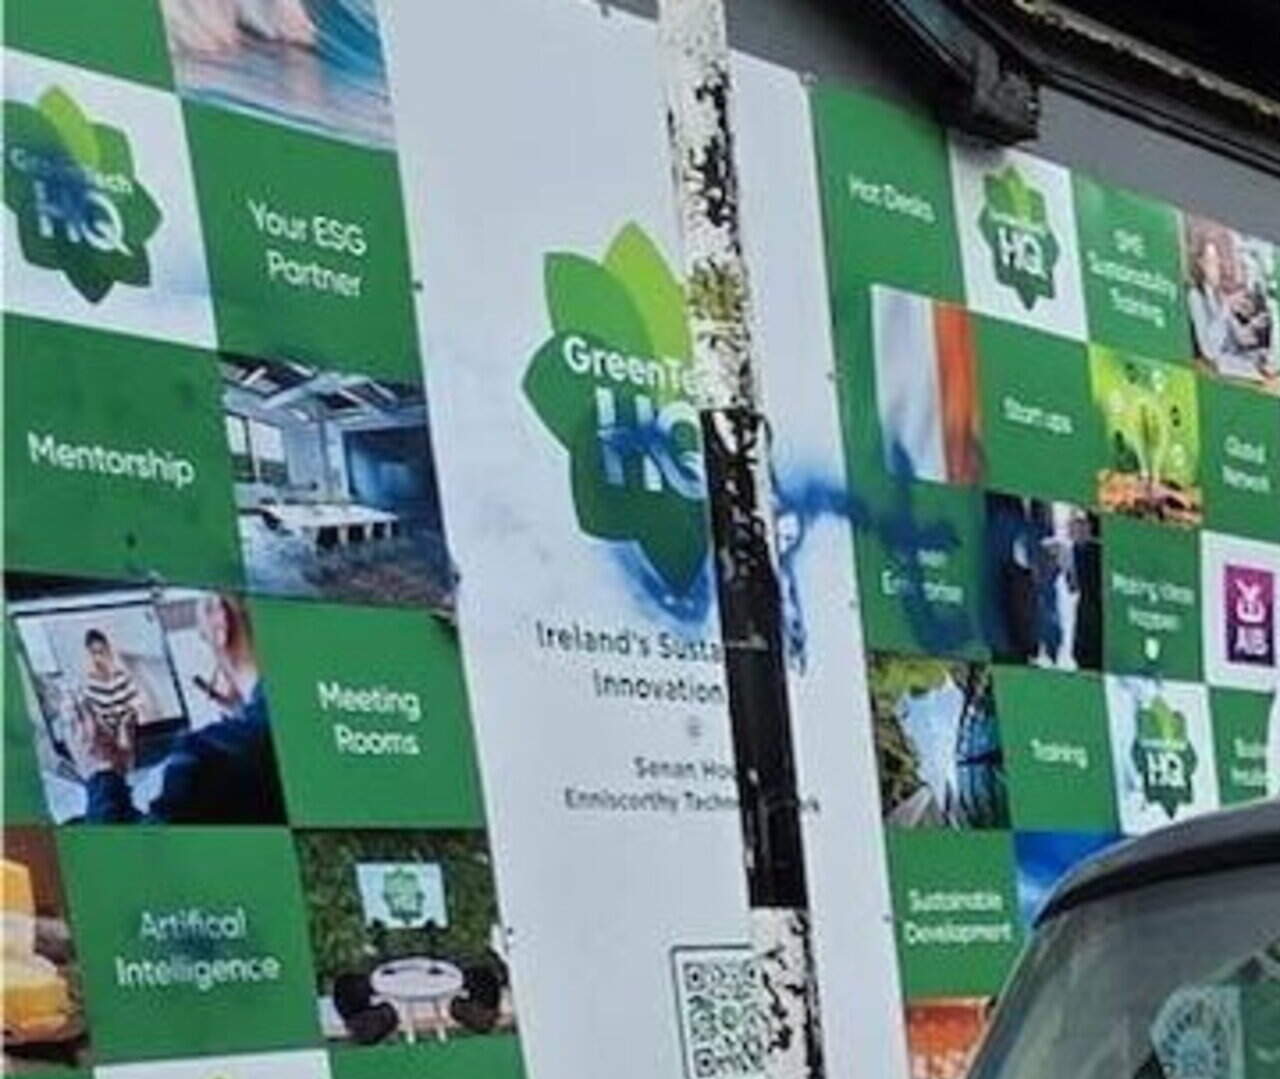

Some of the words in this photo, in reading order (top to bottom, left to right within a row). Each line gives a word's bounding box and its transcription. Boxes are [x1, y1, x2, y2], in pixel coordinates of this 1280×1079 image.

[247, 200, 306, 242] Your
[314, 216, 367, 257] ESG
[1000, 226, 1048, 279] HQ
[265, 250, 362, 297] Partner
[563, 335, 700, 398] GreenTe
[27, 432, 195, 488] Mentorship
[595, 387, 707, 501] HQ
[536, 620, 651, 659] Ireland's
[1235, 625, 1270, 657] AIB
[317, 680, 421, 722] Meeting
[593, 667, 724, 702] Innovation
[333, 724, 420, 756] Rooms
[1148, 752, 1185, 787] HQ
[908, 887, 1004, 913] Sustainable
[903, 920, 1014, 946] Development
[114, 953, 282, 992] Intelligence
